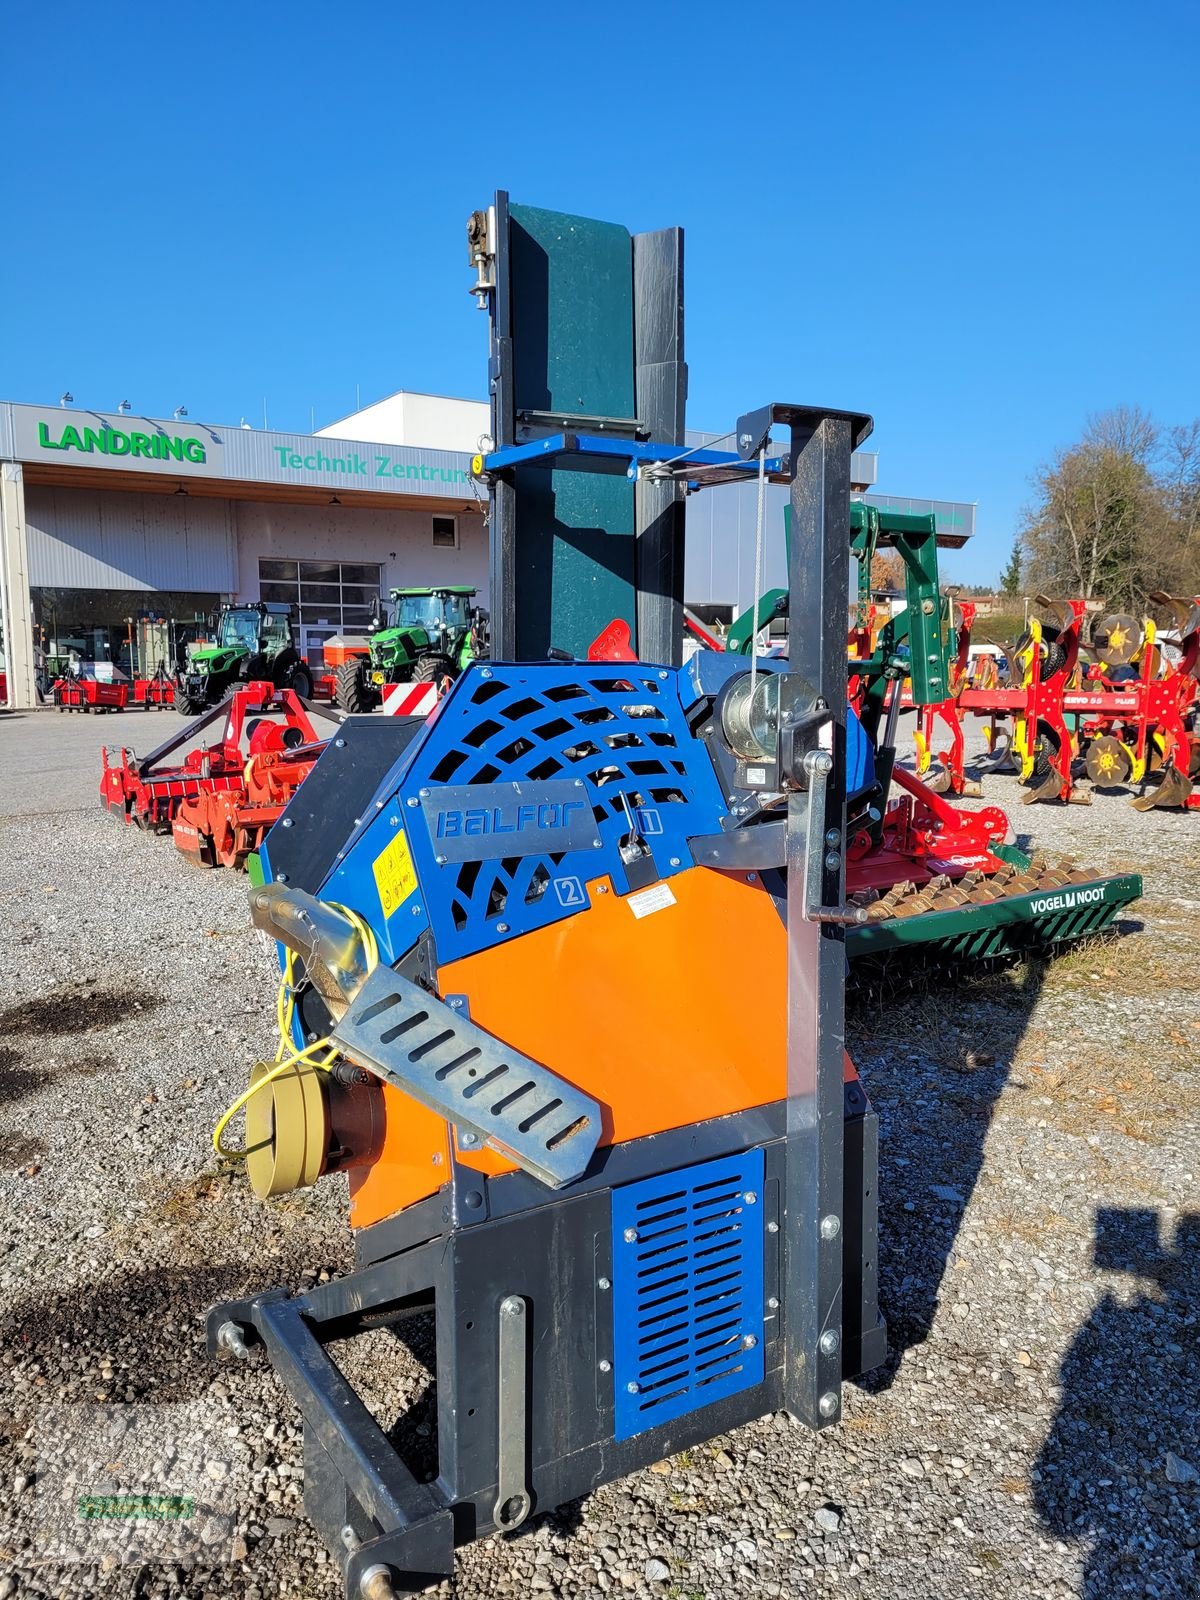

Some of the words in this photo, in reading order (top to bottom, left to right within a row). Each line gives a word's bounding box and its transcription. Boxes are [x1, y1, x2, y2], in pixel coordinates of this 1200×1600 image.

[38, 421, 207, 465] LANDRING
[273, 445, 367, 476] Technik
[643, 812, 655, 831] 1
[561, 880, 579, 902] 2
[1030, 895, 1066, 914] VOGEL
[1076, 887, 1105, 905] NOOT
